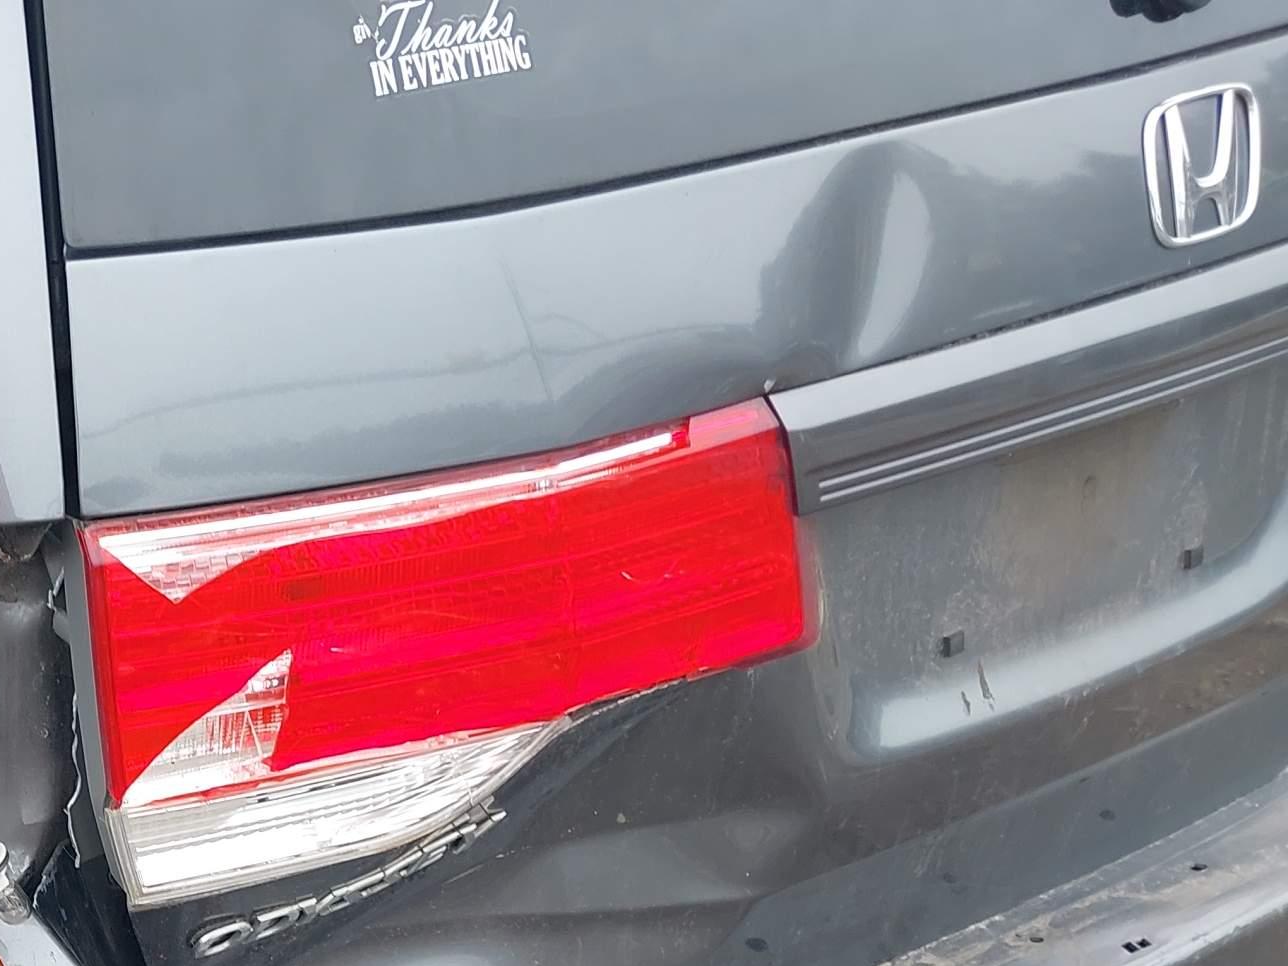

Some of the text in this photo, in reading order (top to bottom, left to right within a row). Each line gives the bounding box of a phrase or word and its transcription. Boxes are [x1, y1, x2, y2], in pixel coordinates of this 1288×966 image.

[376, 0, 513, 60] Thanks
[369, 35, 532, 97] IN EVERYTHING
